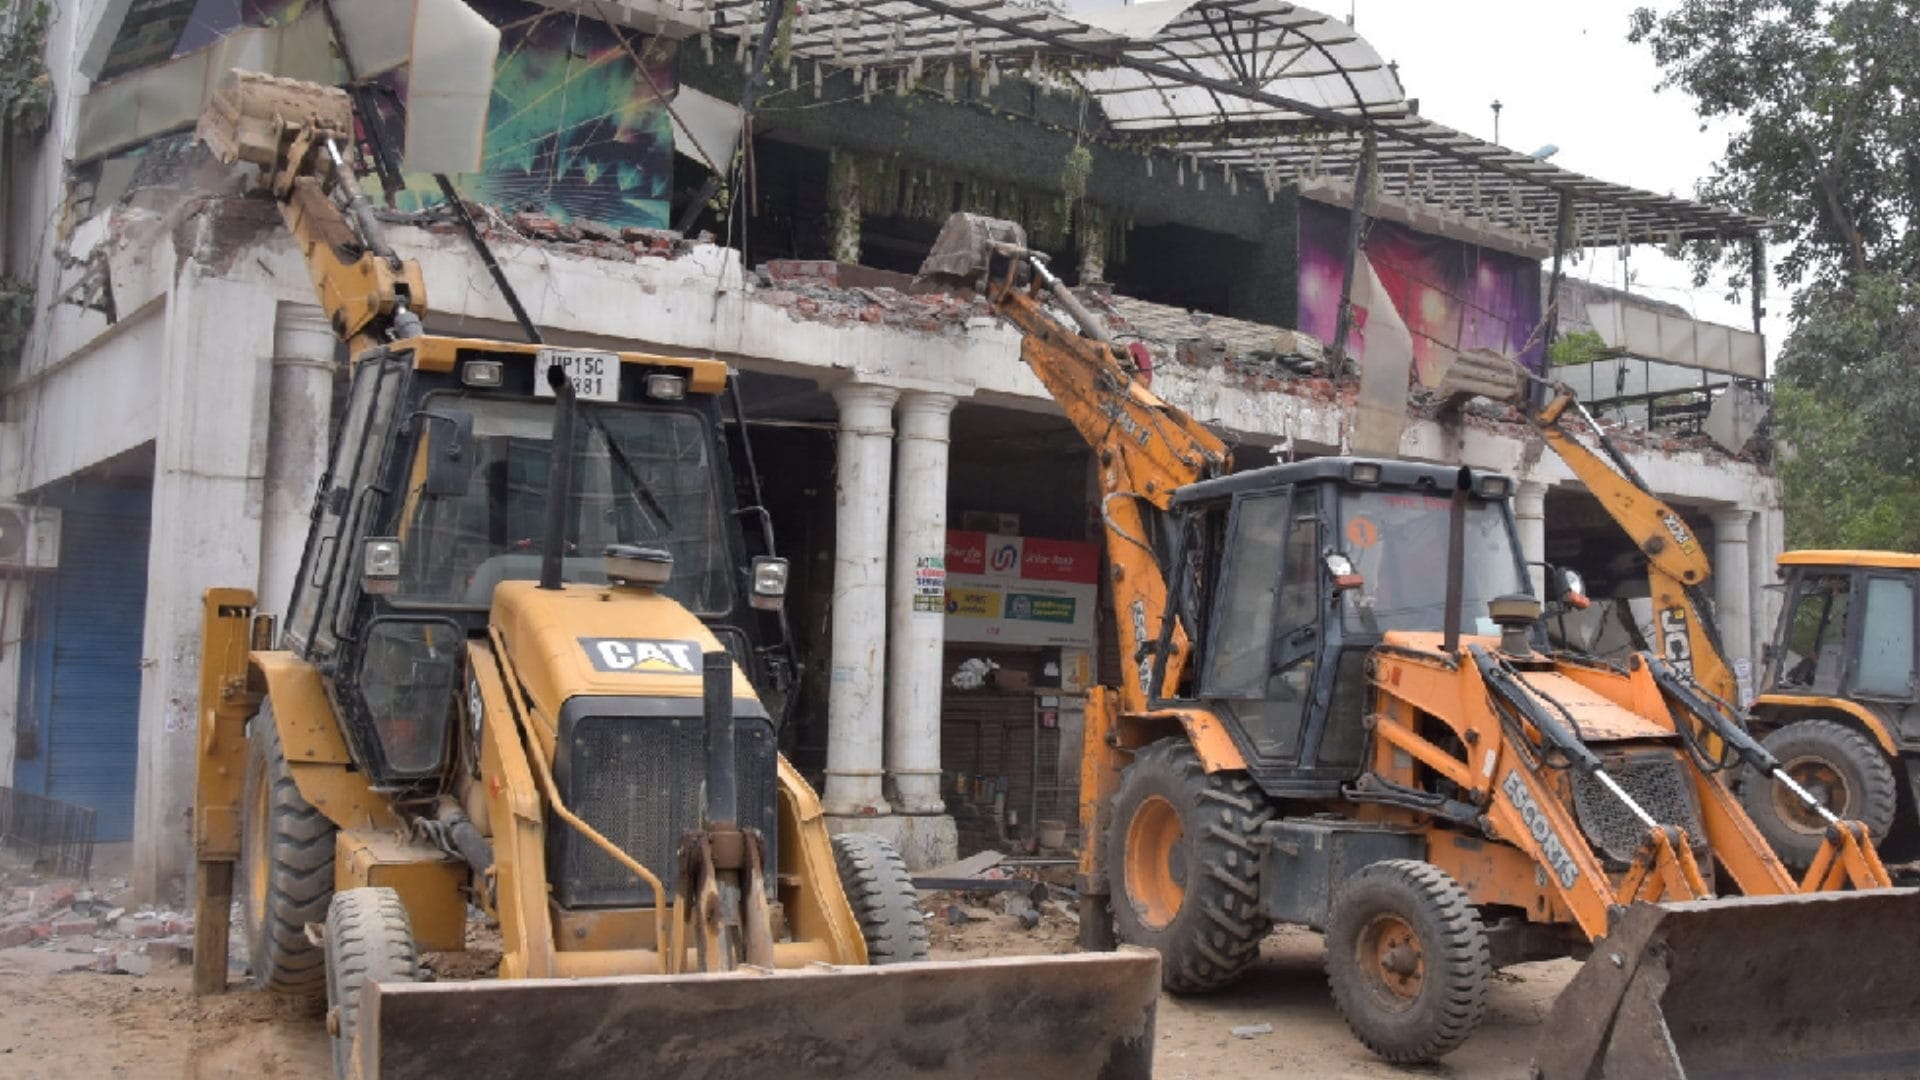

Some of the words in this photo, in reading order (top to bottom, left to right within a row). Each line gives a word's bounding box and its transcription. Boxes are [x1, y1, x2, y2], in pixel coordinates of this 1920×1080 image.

[567, 377, 603, 396] 381
[596, 641, 690, 673] CAT
[1503, 768, 1579, 890] ESCORTS
